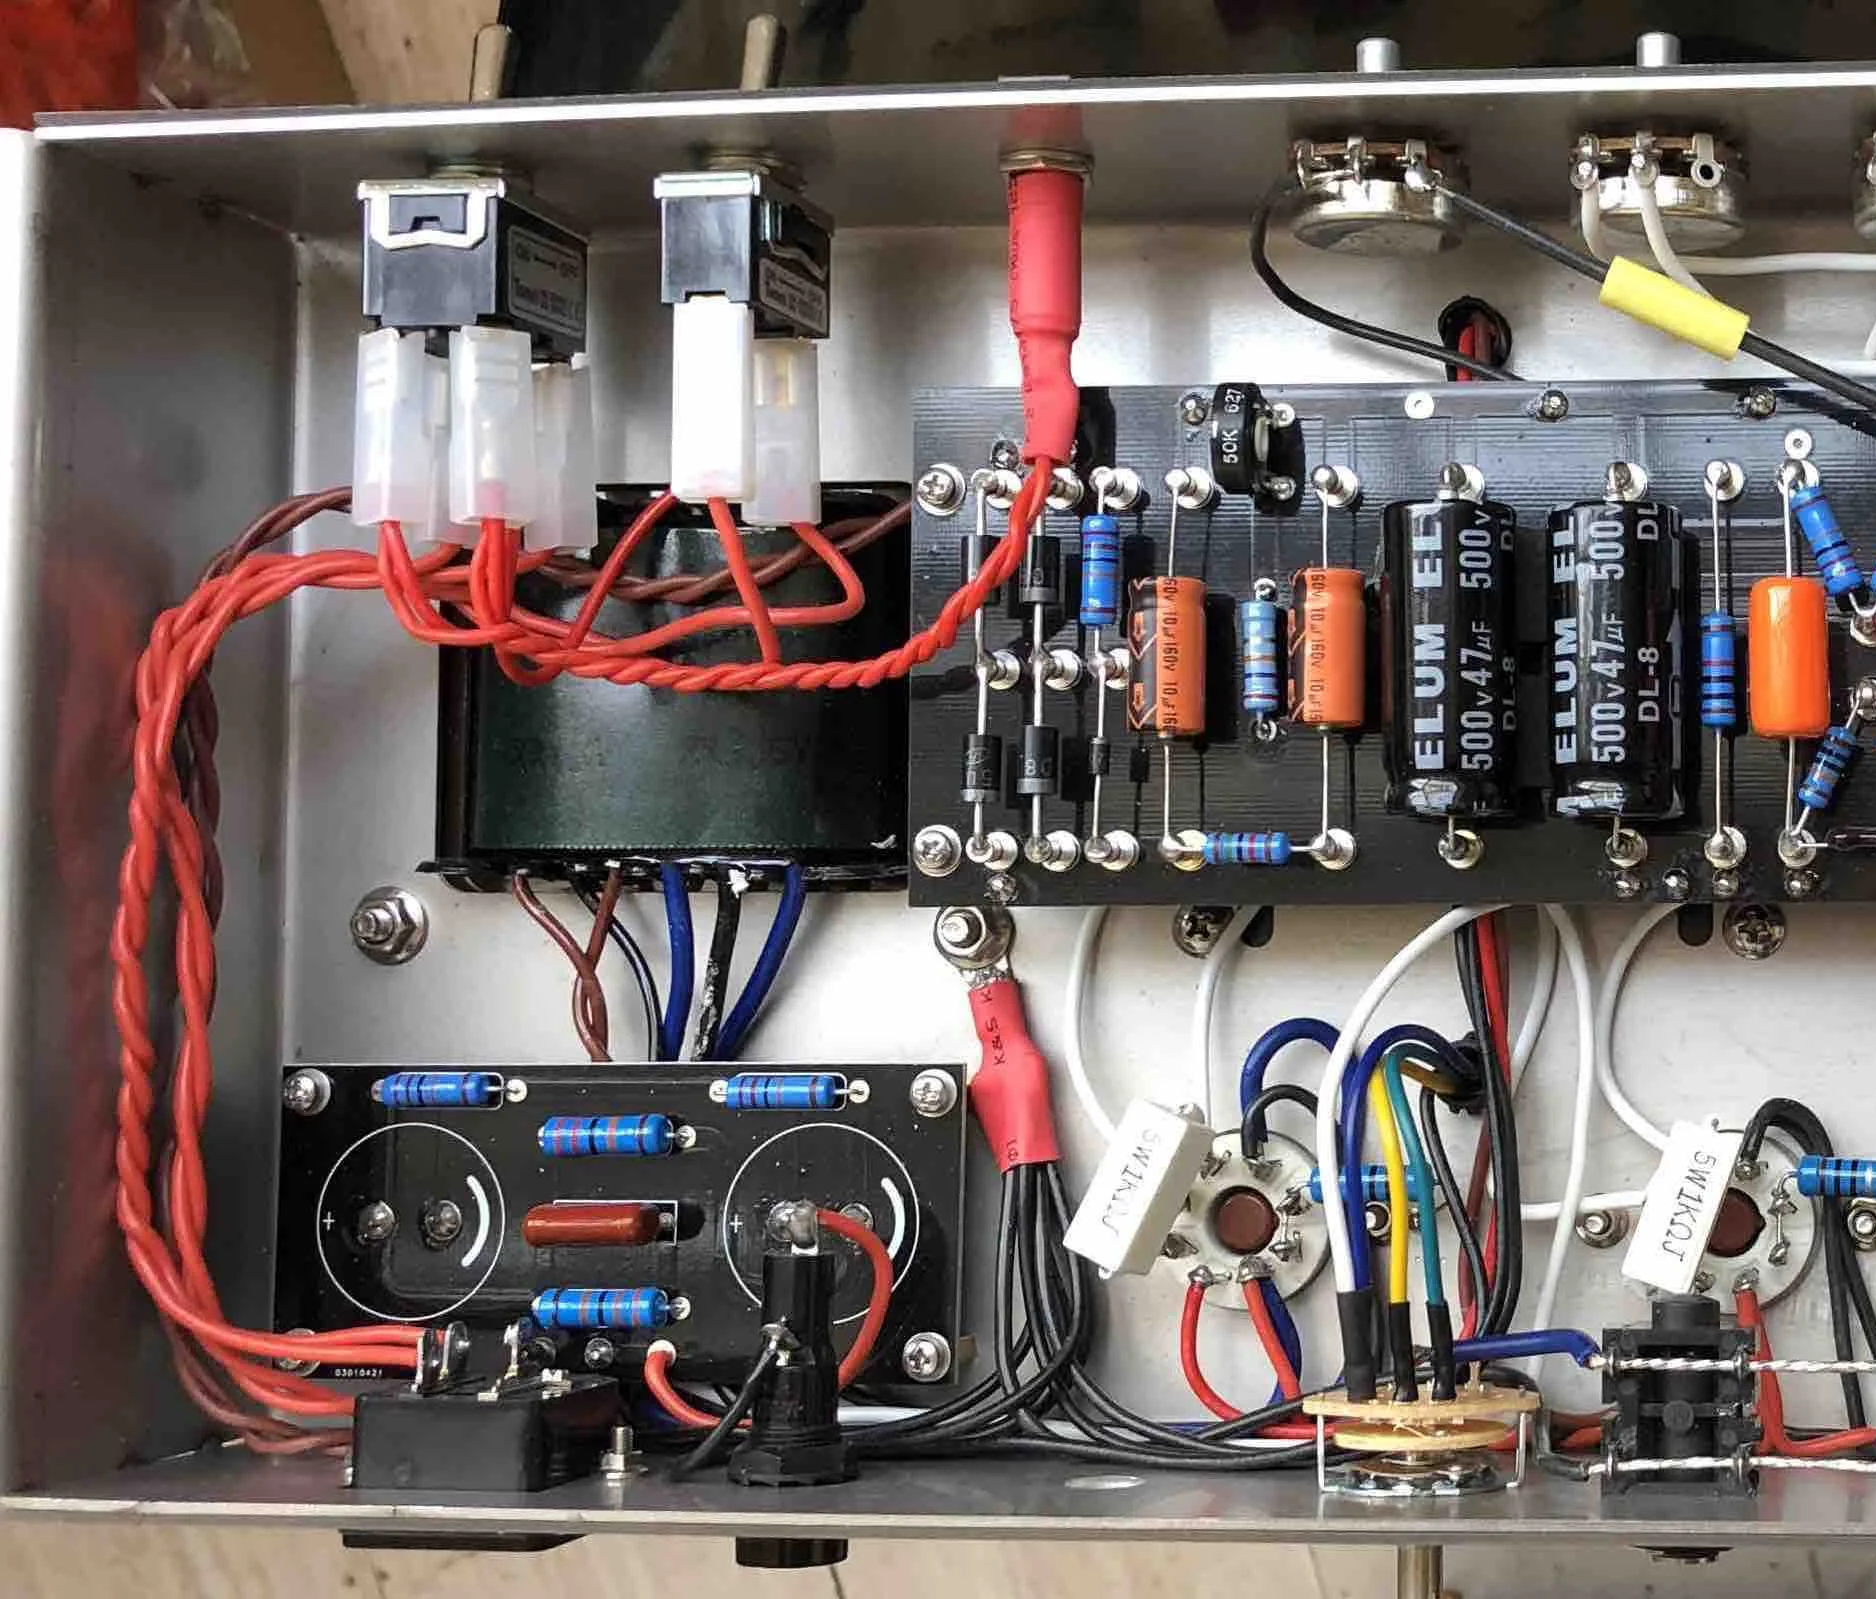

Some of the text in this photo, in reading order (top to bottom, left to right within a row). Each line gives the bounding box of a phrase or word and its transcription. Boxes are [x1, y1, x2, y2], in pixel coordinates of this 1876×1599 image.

[1221, 429, 1239, 464] 50K
[1413, 624, 1446, 769] ELUM
[1554, 617, 1578, 765] ELUM
[1636, 646, 1661, 723] DL-8
